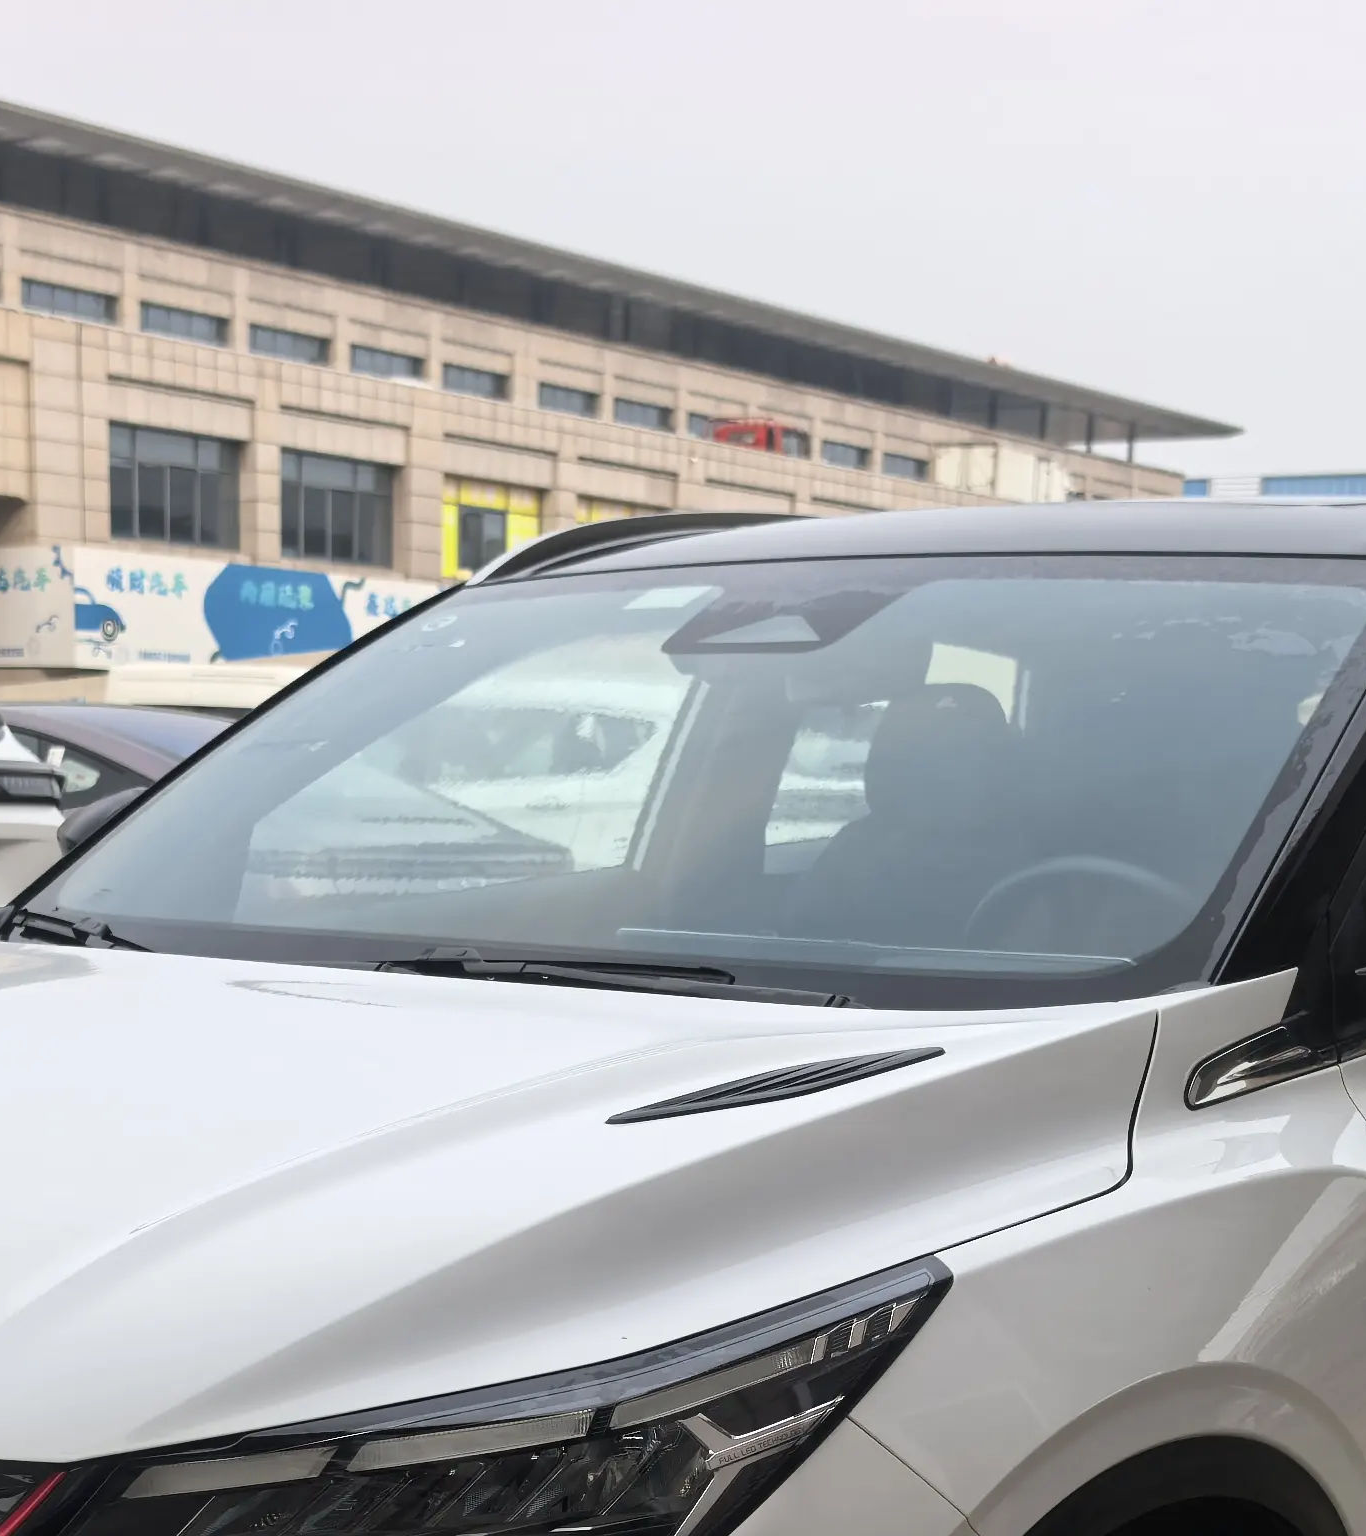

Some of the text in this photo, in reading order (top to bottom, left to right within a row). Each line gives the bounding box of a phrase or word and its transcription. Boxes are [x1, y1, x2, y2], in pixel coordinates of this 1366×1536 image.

[718, 1427, 805, 1464] FULL LED TECHNOLOGY
